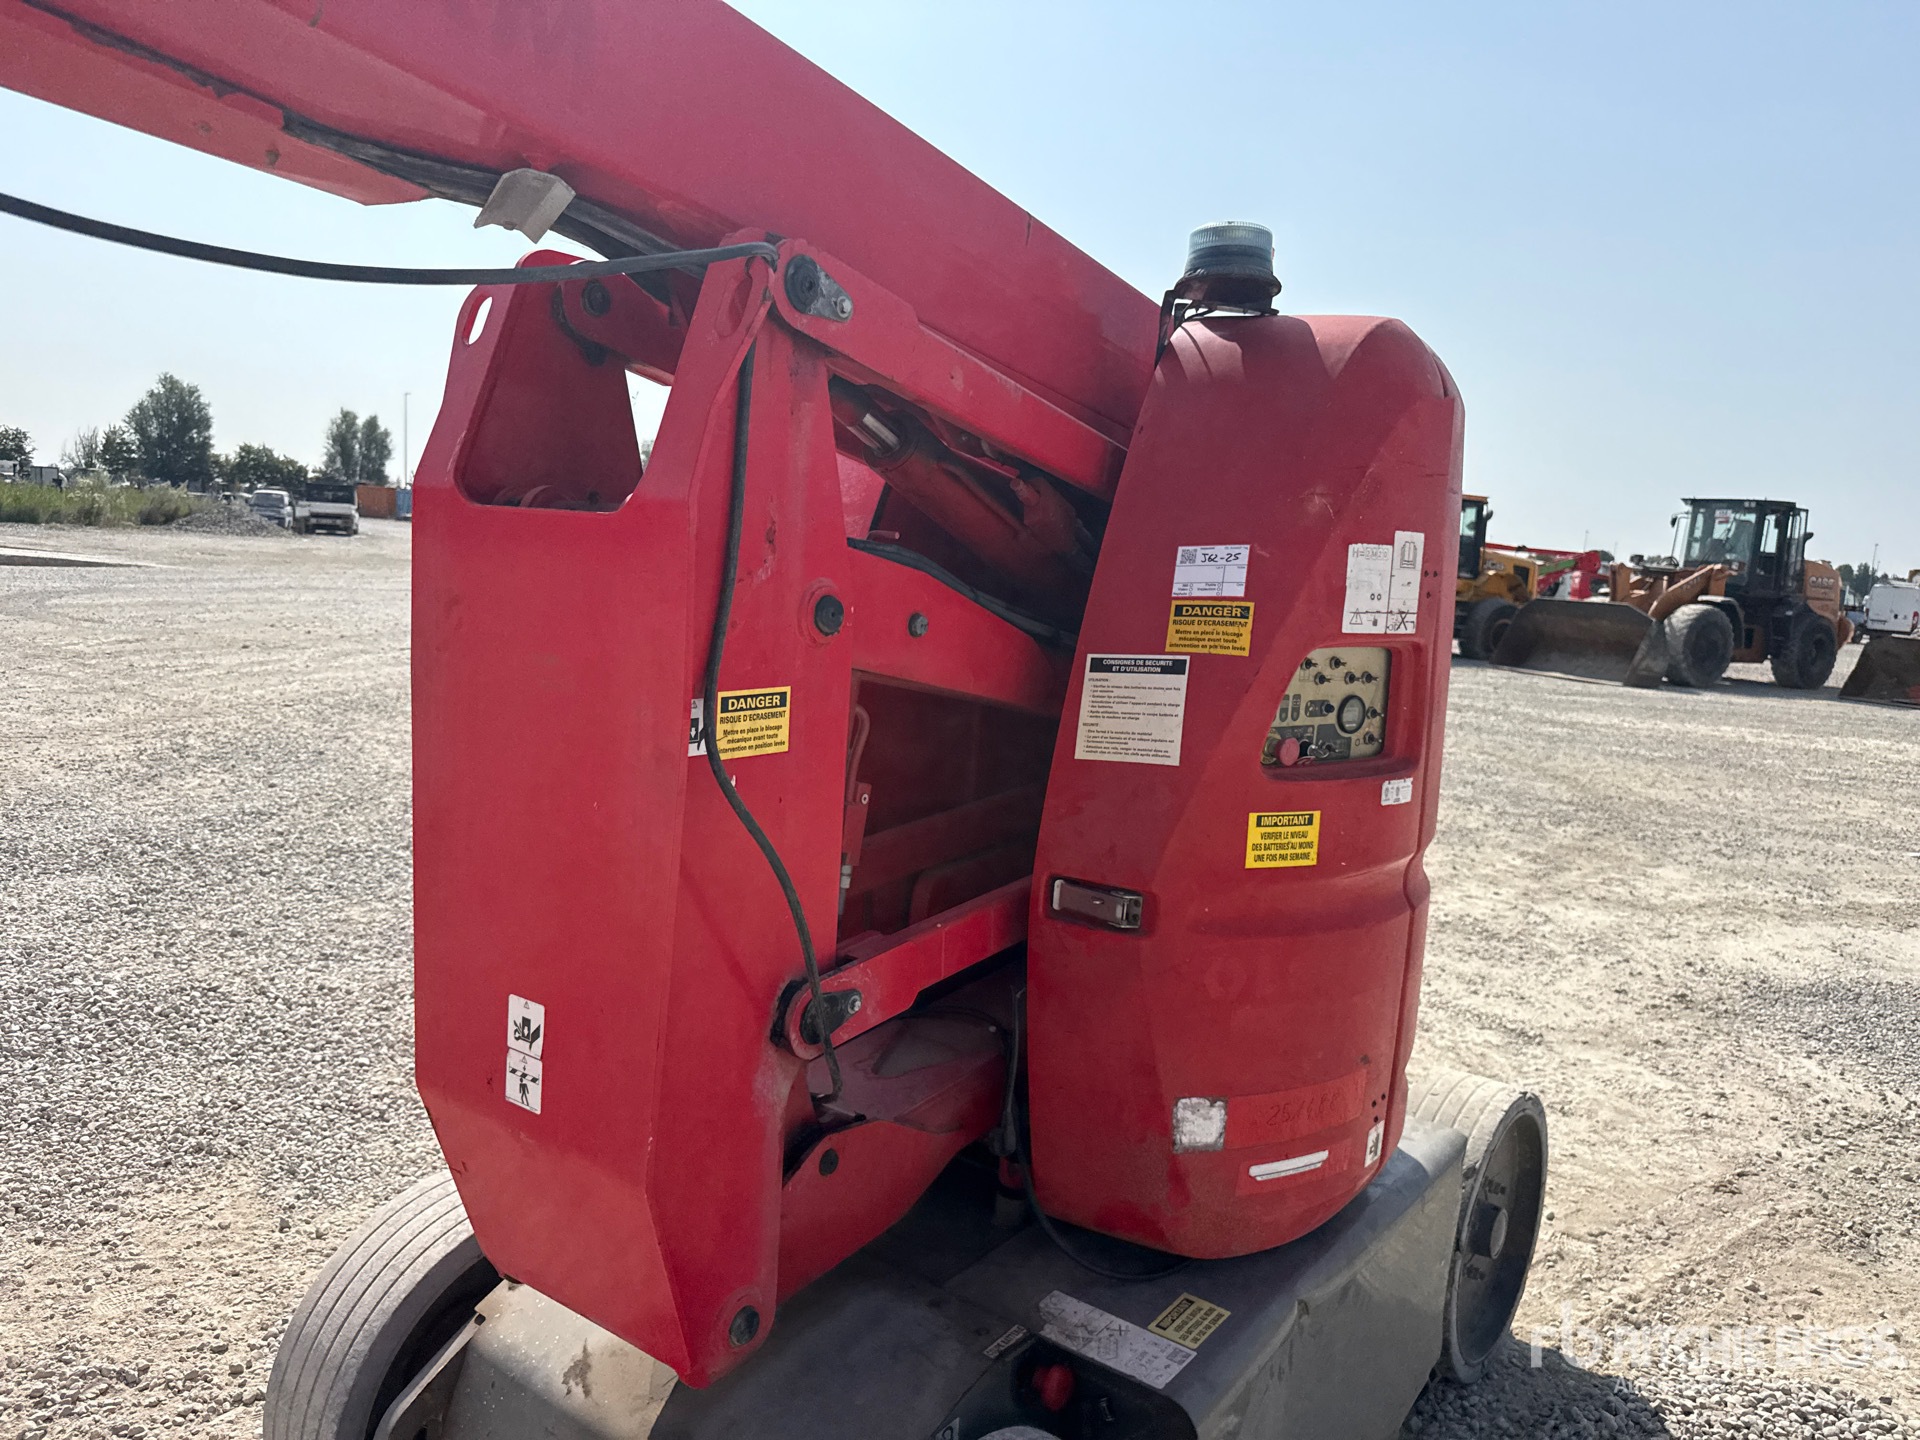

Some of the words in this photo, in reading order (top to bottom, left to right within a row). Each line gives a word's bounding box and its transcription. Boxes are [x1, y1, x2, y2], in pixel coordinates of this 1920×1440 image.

[1182, 606, 1241, 617] DANGER
[728, 695, 781, 710] DANGER
[720, 715, 741, 724] RISQUE
[743, 710, 786, 722] D'ECRASEMENT
[747, 726, 759, 734] place
[765, 724, 782, 732] blocage
[727, 736, 754, 744] mécanique
[719, 745, 747, 754] intervention
[754, 742, 773, 751] position
[1261, 815, 1310, 826] IMPORTANT
[1261, 832, 1282, 840] VERIFIER
[1284, 831, 1289, 839] LE
[1290, 831, 1308, 839] NIVEAU
[1252, 843, 1262, 851] DES
[1263, 842, 1289, 851] BATTERIES
[1298, 841, 1314, 849] MOINS
[1254, 854, 1265, 862] UNE
[1266, 854, 1277, 862] FOIS
[1279, 853, 1288, 861] PAR
